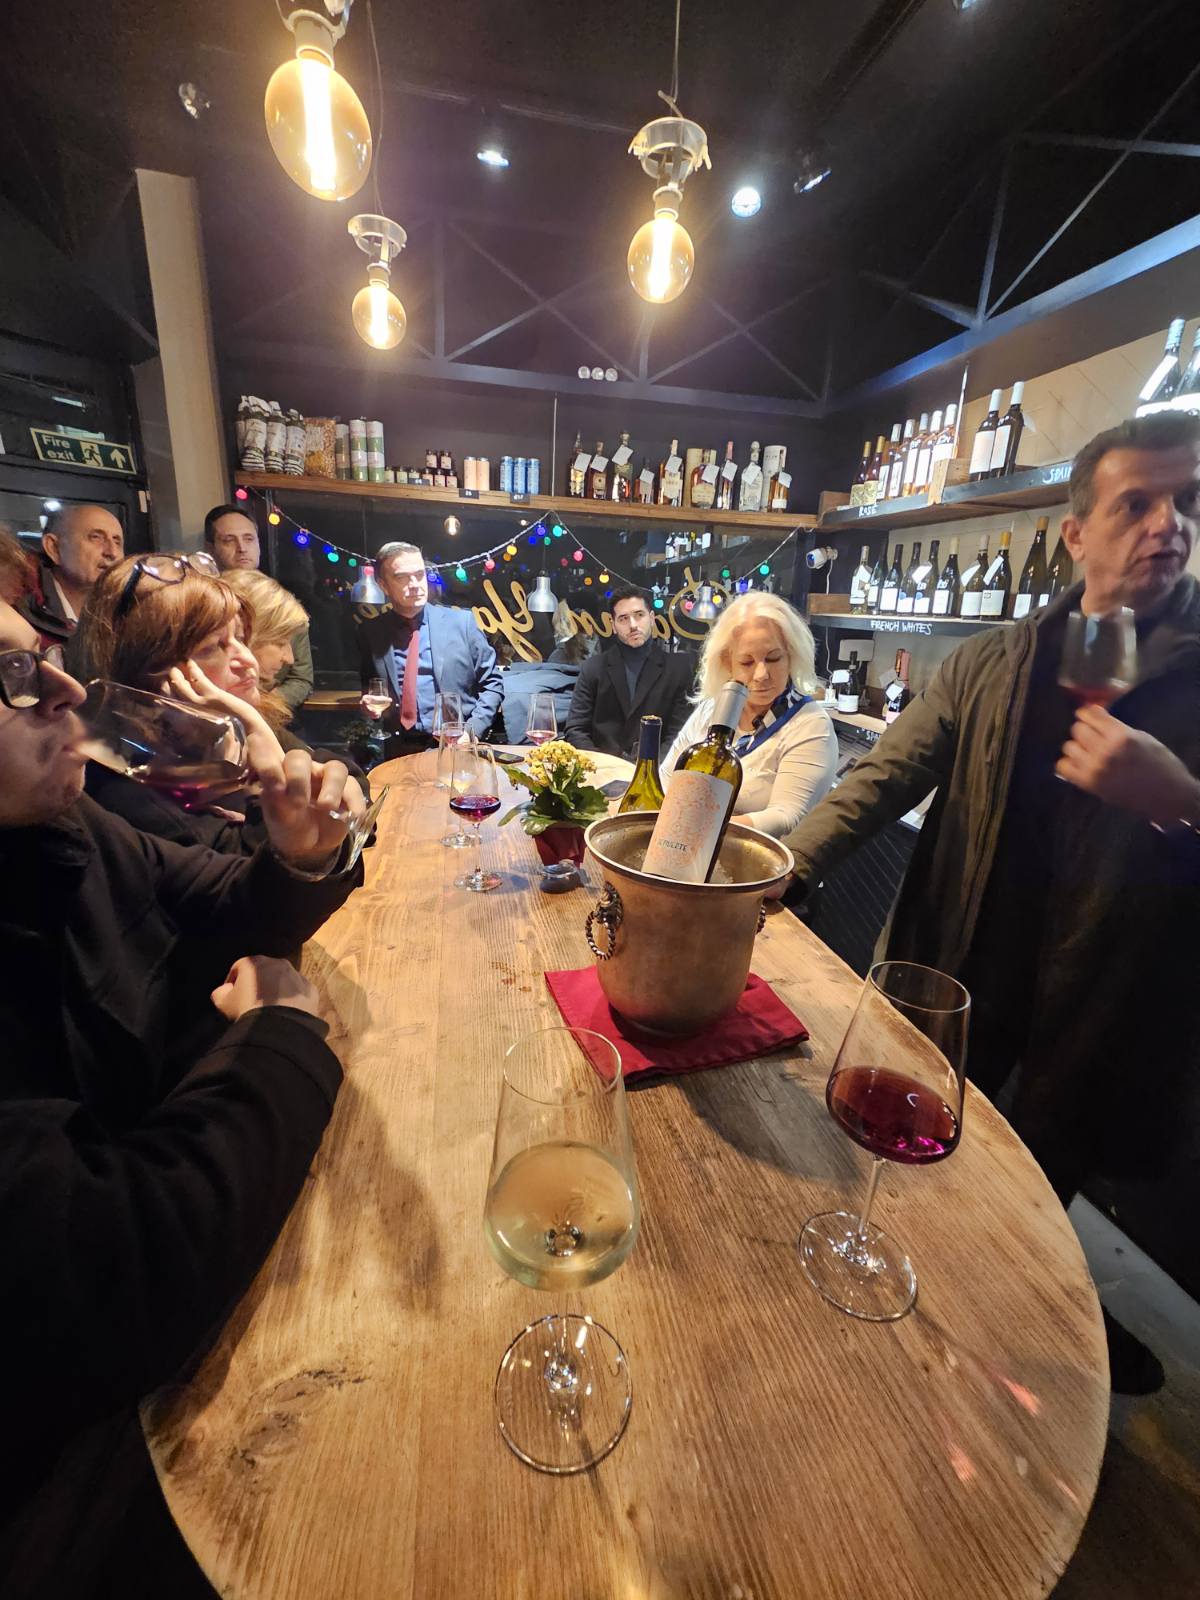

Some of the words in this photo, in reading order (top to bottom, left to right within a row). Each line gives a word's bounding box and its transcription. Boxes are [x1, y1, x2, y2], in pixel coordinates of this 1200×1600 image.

[42, 434, 71, 449] Fire
[47, 449, 76, 462] exit
[870, 620, 900, 633] FRENCH
[901, 622, 933, 636] WHITES
